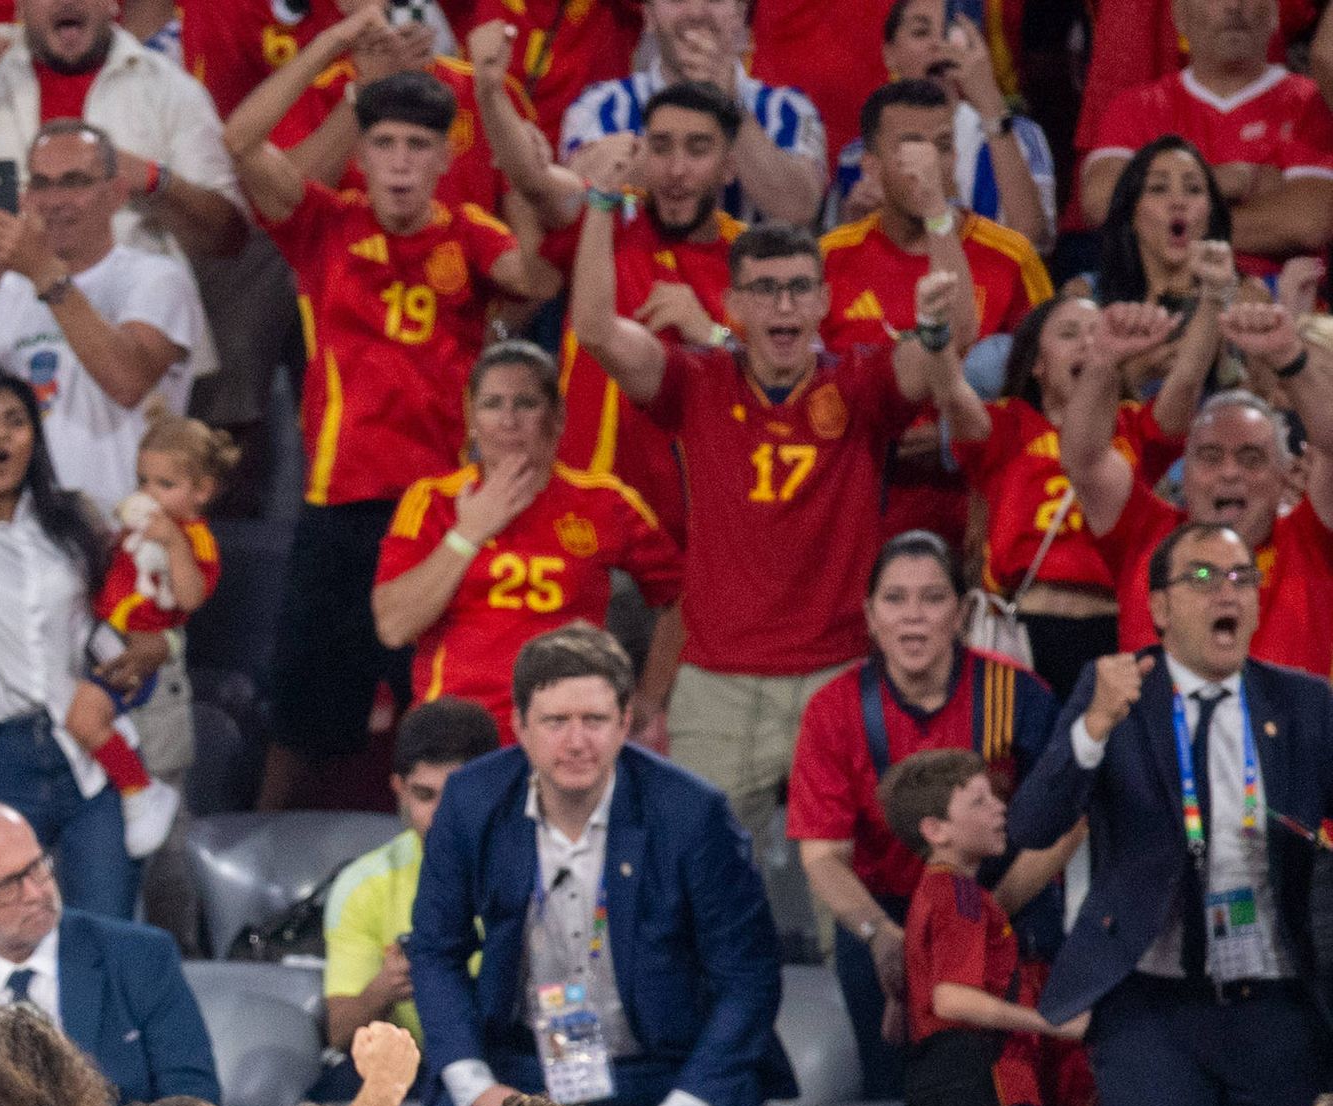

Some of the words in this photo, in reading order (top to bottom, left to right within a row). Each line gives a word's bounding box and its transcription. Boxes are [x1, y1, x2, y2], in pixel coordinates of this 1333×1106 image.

[382, 281, 436, 344] 19
[750, 444, 817, 501] 17
[488, 552, 565, 612] 25
